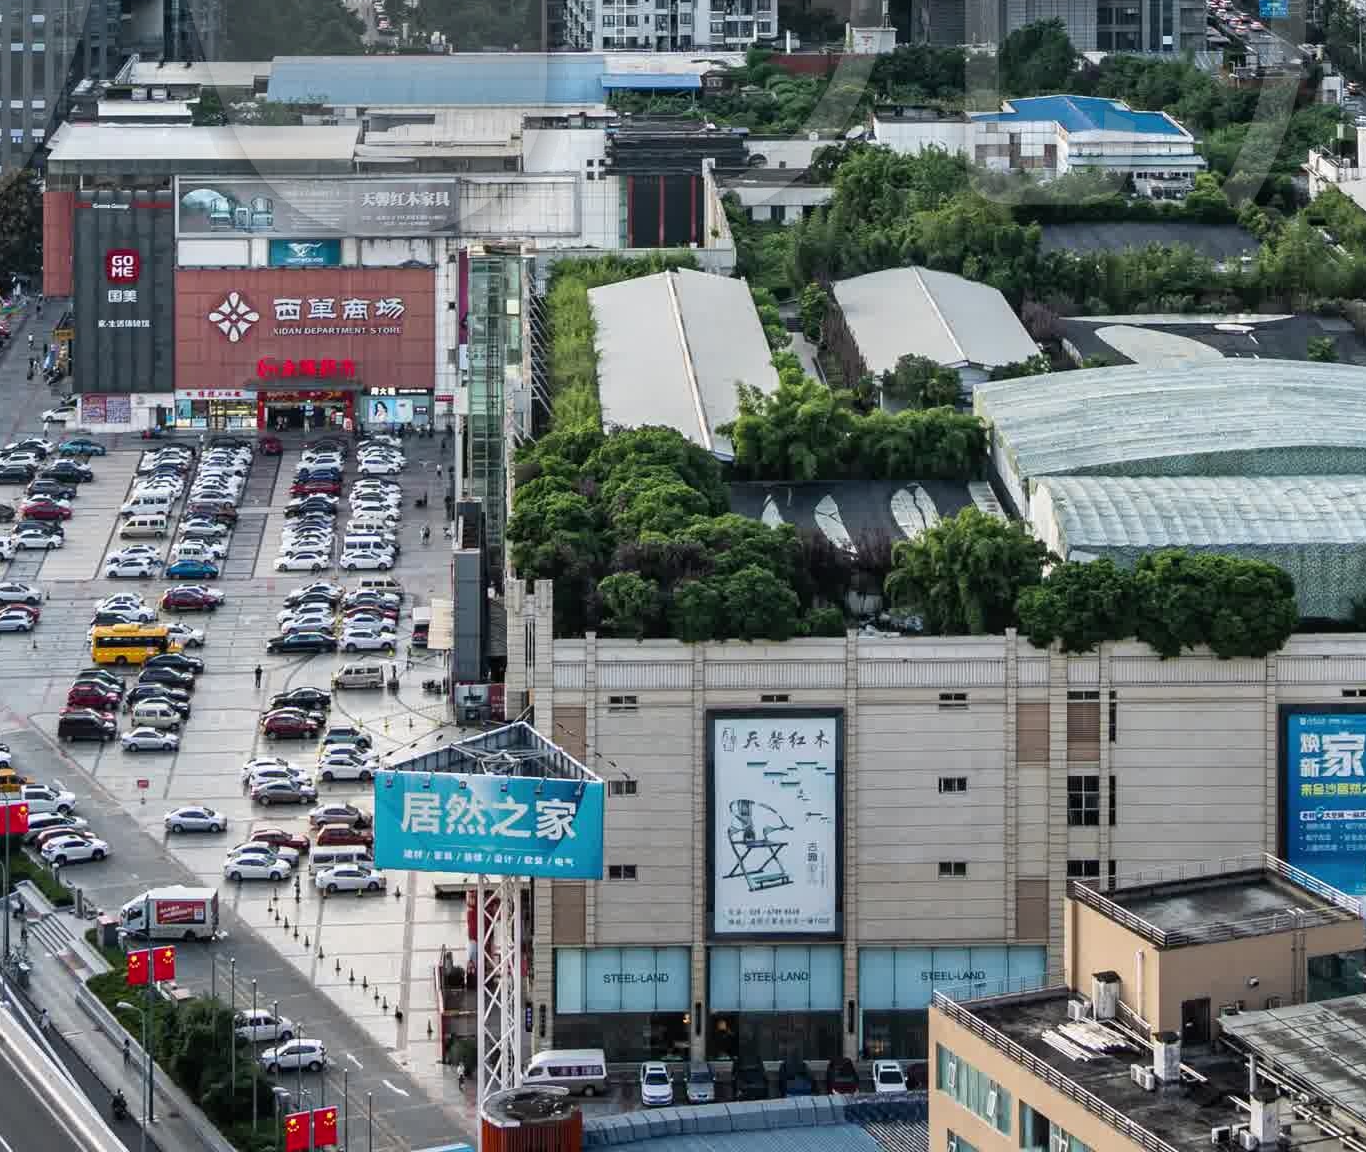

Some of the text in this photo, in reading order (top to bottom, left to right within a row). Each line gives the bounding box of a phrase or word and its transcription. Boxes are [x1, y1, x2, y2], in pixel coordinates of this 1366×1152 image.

[112, 255, 133, 266] GO
[112, 266, 133, 277] ME
[108, 289, 137, 302] 国美
[273, 298, 405, 320] 西单商场
[274, 327, 402, 335] XIDAN DEPARTMENT STORE
[401, 792, 577, 841] 居然之家
[602, 972, 669, 984] STEEL-LAND
[743, 971, 809, 982] STEEL-LAND
[920, 970, 986, 982] STEEL-LAND
